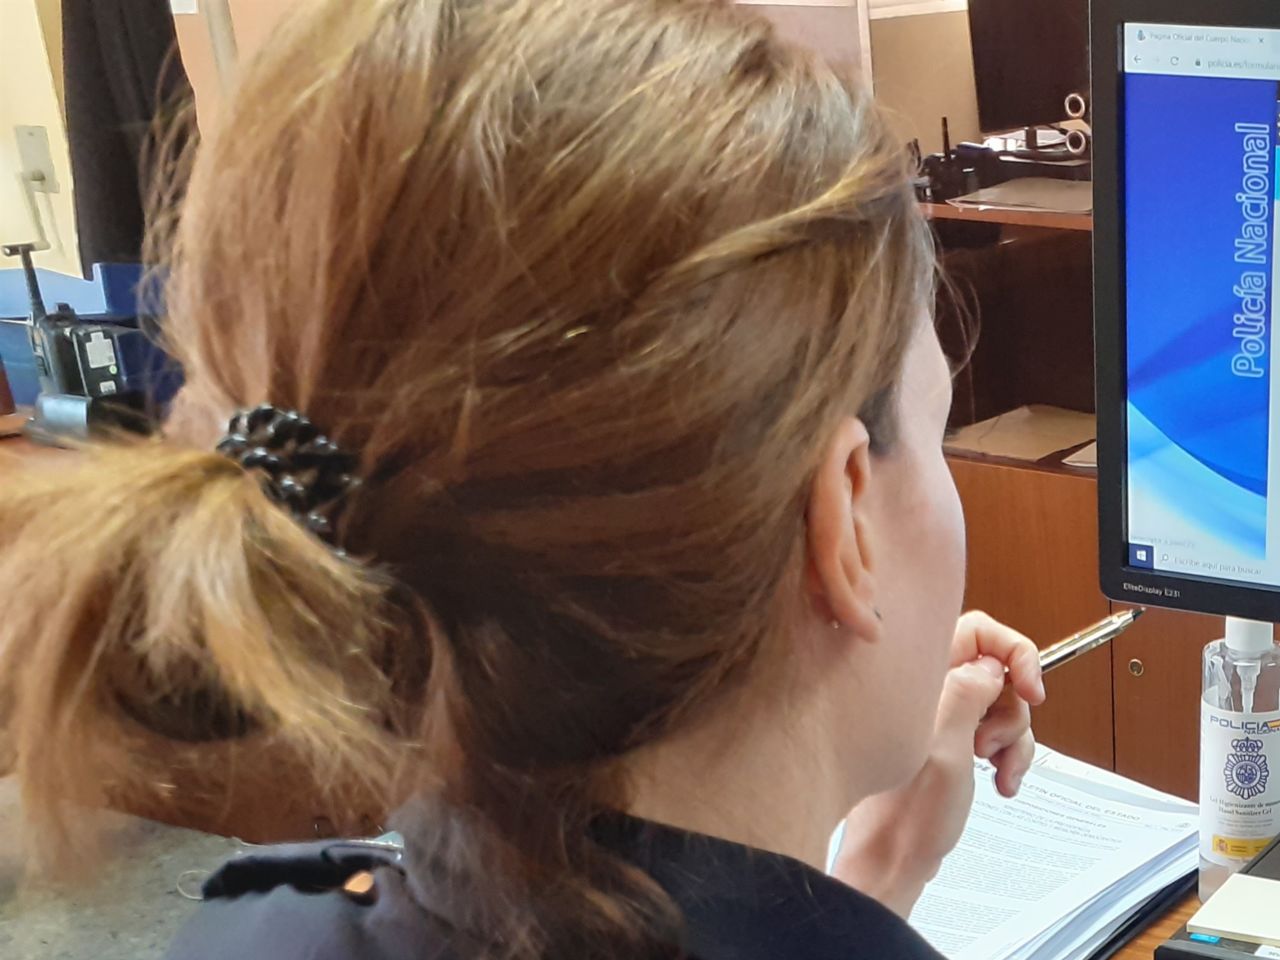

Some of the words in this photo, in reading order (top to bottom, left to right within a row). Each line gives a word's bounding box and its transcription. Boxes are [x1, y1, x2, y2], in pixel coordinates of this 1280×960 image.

[1234, 122, 1271, 264] Nacional
[1231, 271, 1267, 378] Policía
[1174, 556, 1200, 567] Escribe
[1219, 563, 1236, 573] para
[1237, 564, 1262, 575] buscar
[1209, 715, 1270, 732] POLICIA
